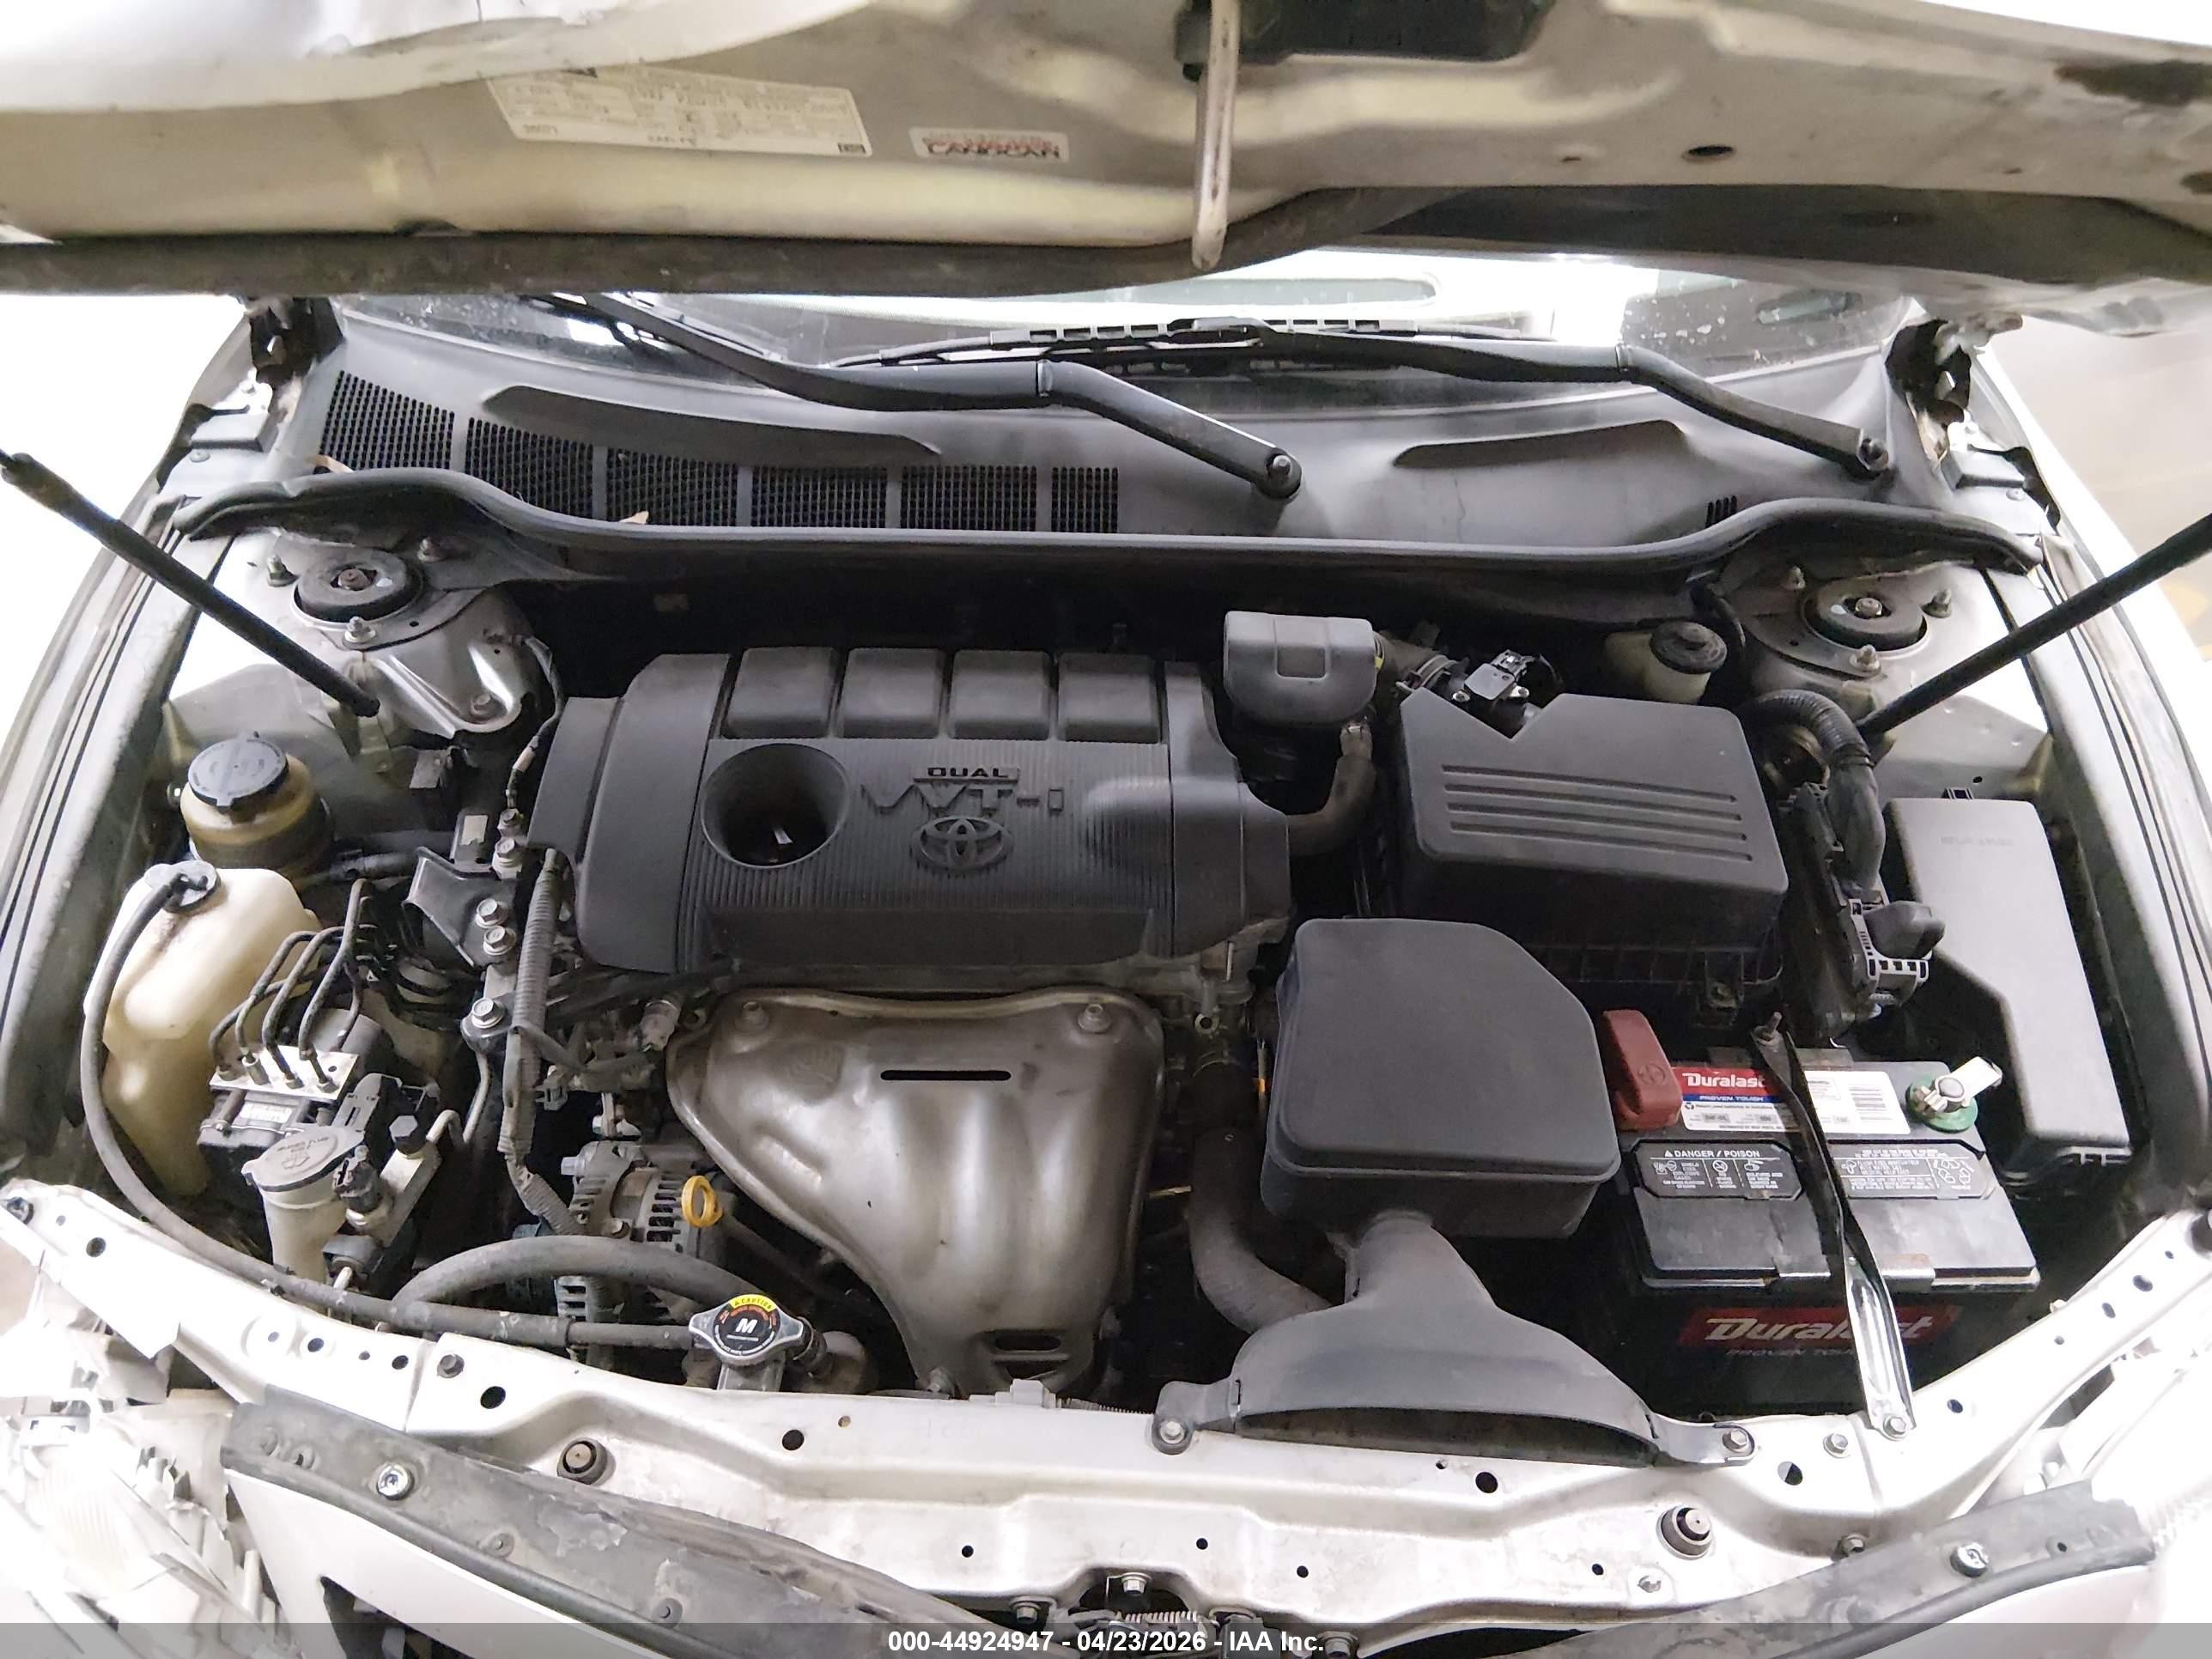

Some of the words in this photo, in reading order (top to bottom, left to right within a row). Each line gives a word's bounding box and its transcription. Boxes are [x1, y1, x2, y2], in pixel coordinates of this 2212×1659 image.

[927, 768, 1008, 778] DUAL
[1682, 1073, 1766, 1088] Duralast
[741, 1297, 772, 1310] CAUTION
[735, 1318, 757, 1334] M
